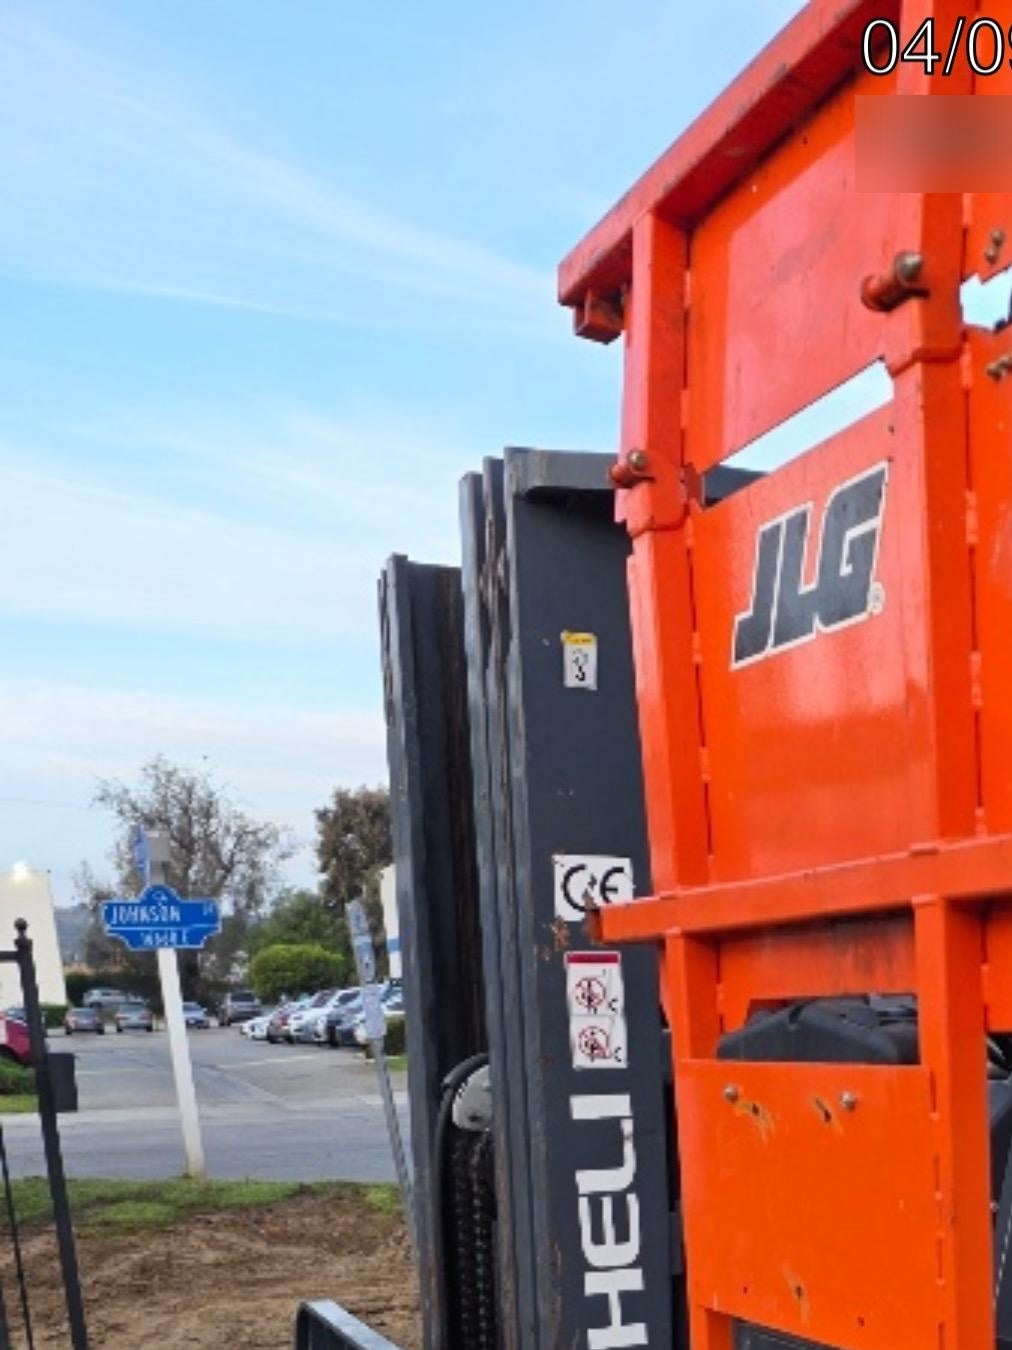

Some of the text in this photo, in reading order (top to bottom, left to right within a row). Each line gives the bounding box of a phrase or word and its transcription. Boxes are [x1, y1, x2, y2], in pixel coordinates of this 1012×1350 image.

[730, 459, 889, 671] JLG
[110, 904, 181, 925] JOHNSON
[561, 864, 625, 912] CE
[569, 1094, 648, 1350] HELI
